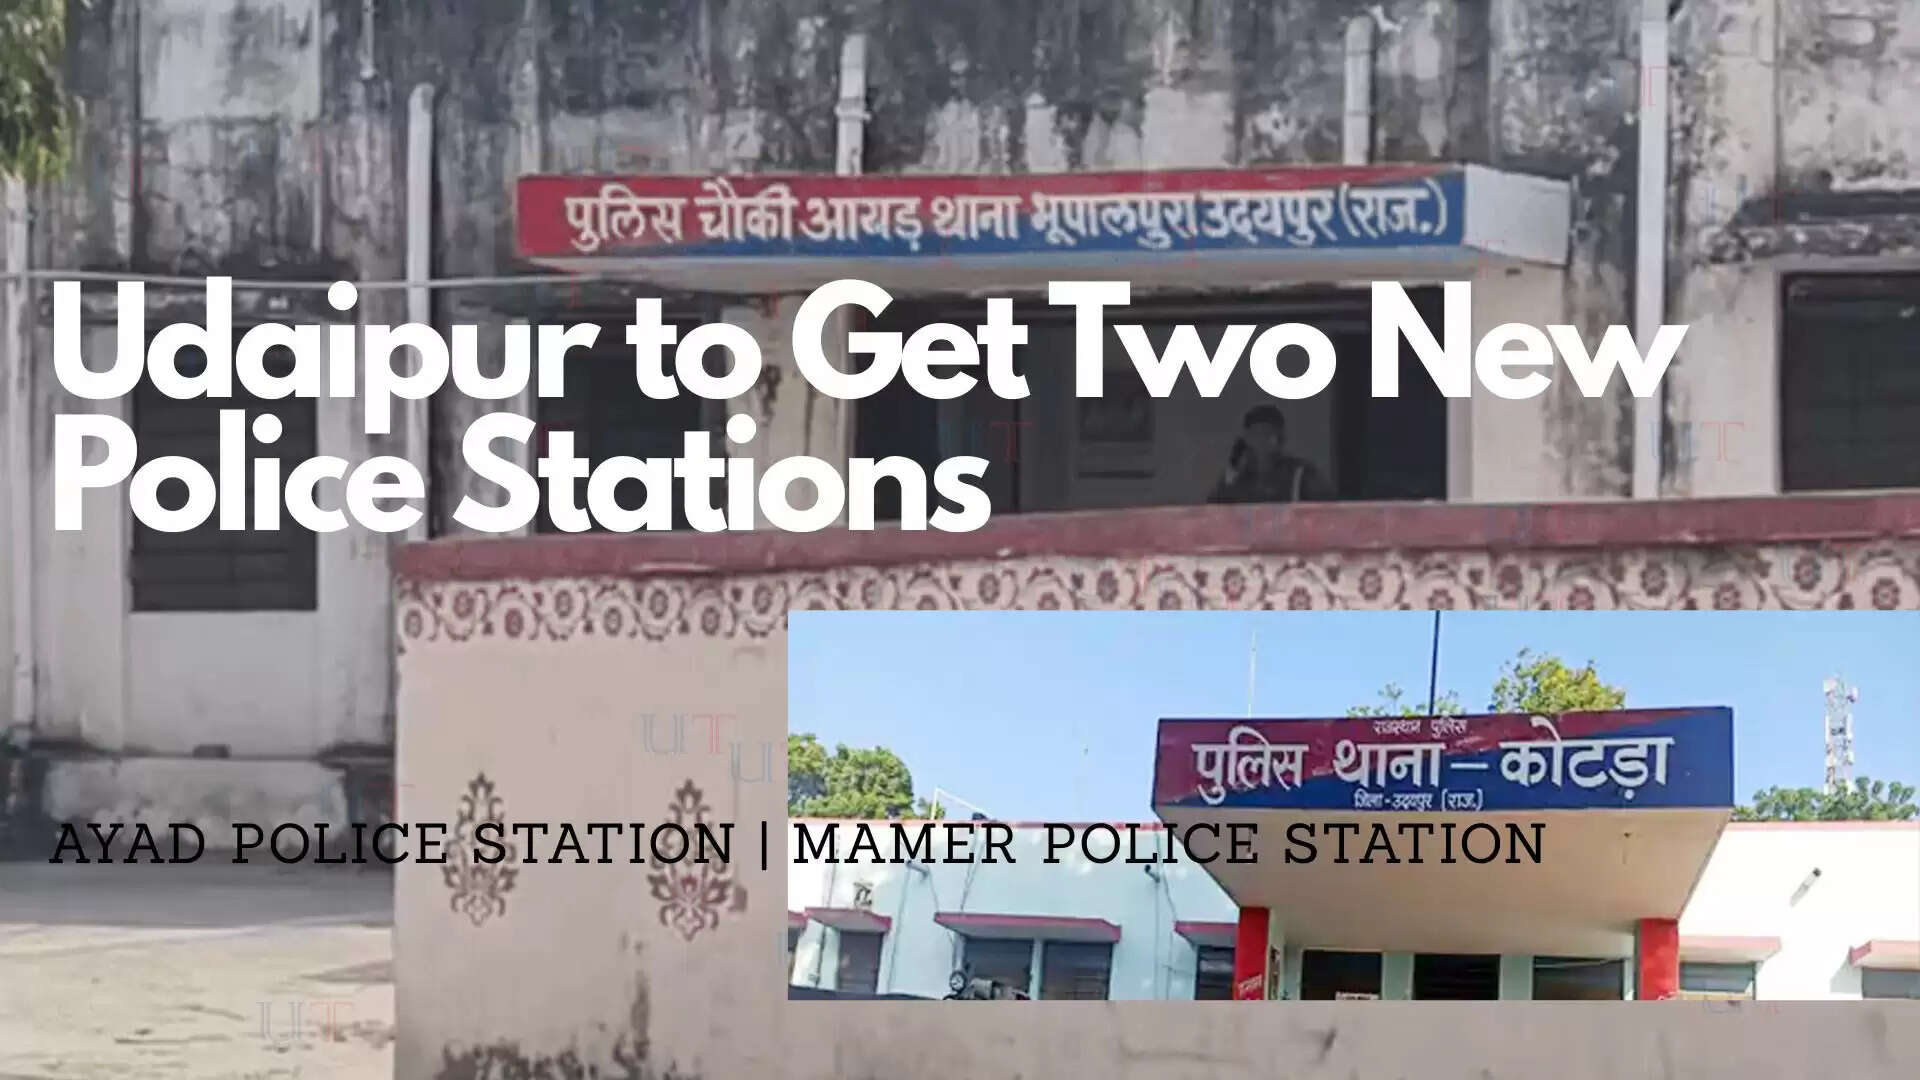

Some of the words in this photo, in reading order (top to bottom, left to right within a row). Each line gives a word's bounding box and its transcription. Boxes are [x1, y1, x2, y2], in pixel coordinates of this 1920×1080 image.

[565, 182, 687, 251] पुलिस
[694, 177, 799, 243] चौकी
[799, 196, 923, 251] आयड़
[931, 195, 1023, 240] थाना
[1031, 191, 1198, 249] भूपालपुरा
[1200, 188, 1338, 246] उदयपुर
[1338, 177, 1447, 239] (राज.)
[1192, 725, 1309, 805] पुलिस
[1333, 739, 1446, 788] थाना
[1499, 715, 1675, 800] कोटड़ा
